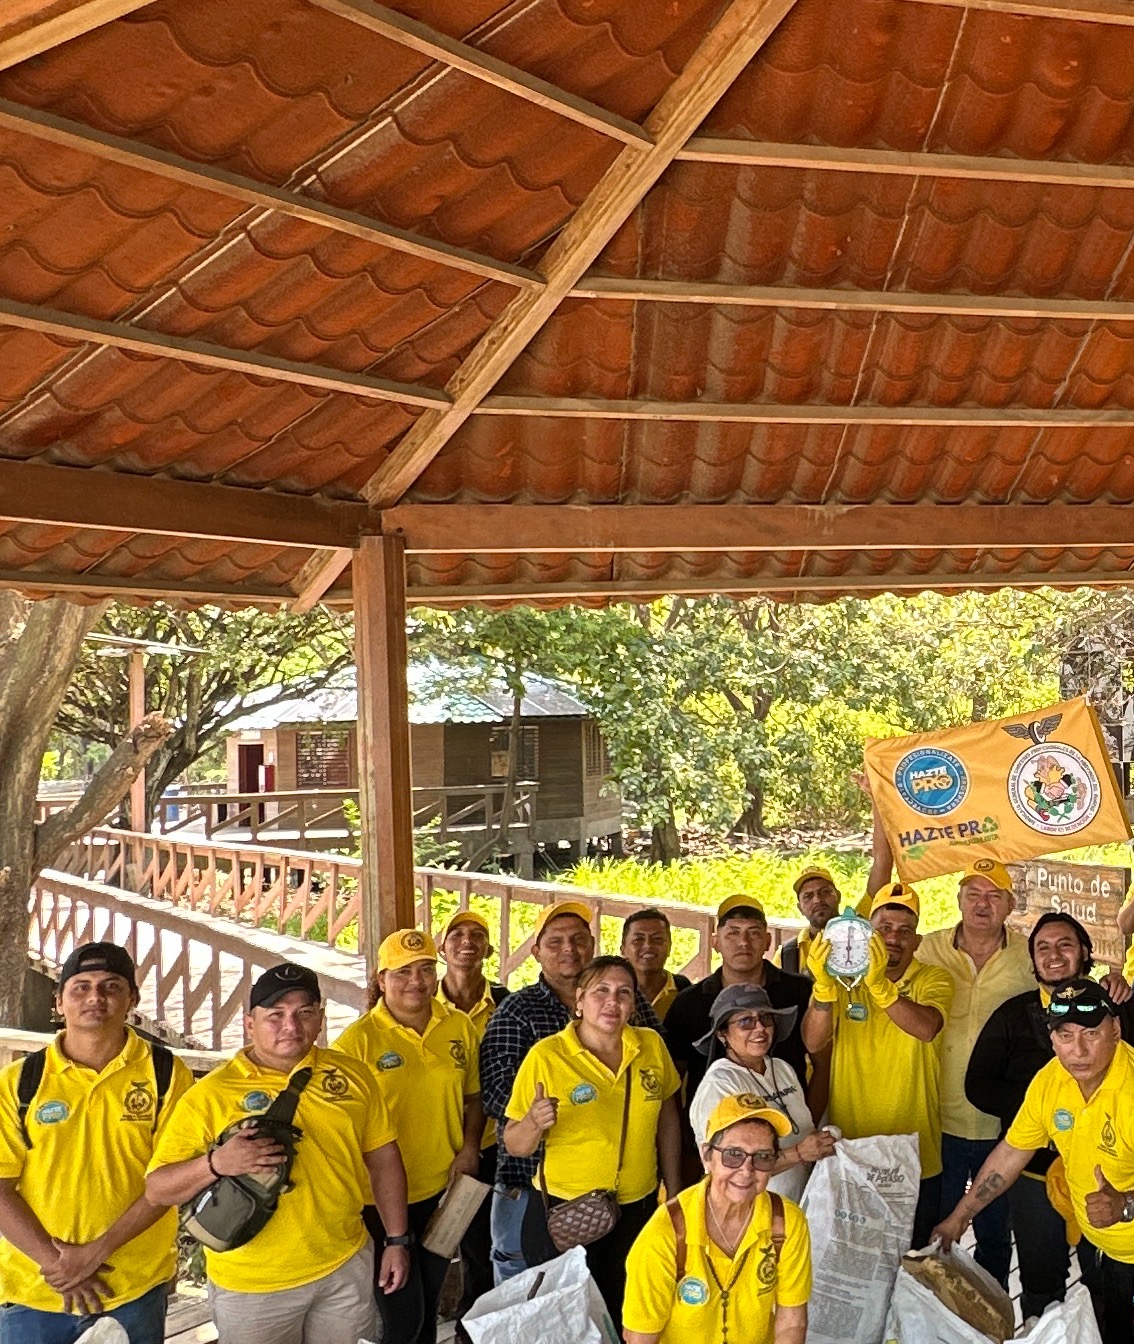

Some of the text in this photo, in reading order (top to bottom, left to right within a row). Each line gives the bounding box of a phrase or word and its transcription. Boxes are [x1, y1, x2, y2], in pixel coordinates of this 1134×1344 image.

[909, 766, 947, 780] HAZTE
[898, 827, 955, 848] HAZTE
[1037, 867, 1111, 898] Punto de
[1051, 895, 1097, 923] Salud
